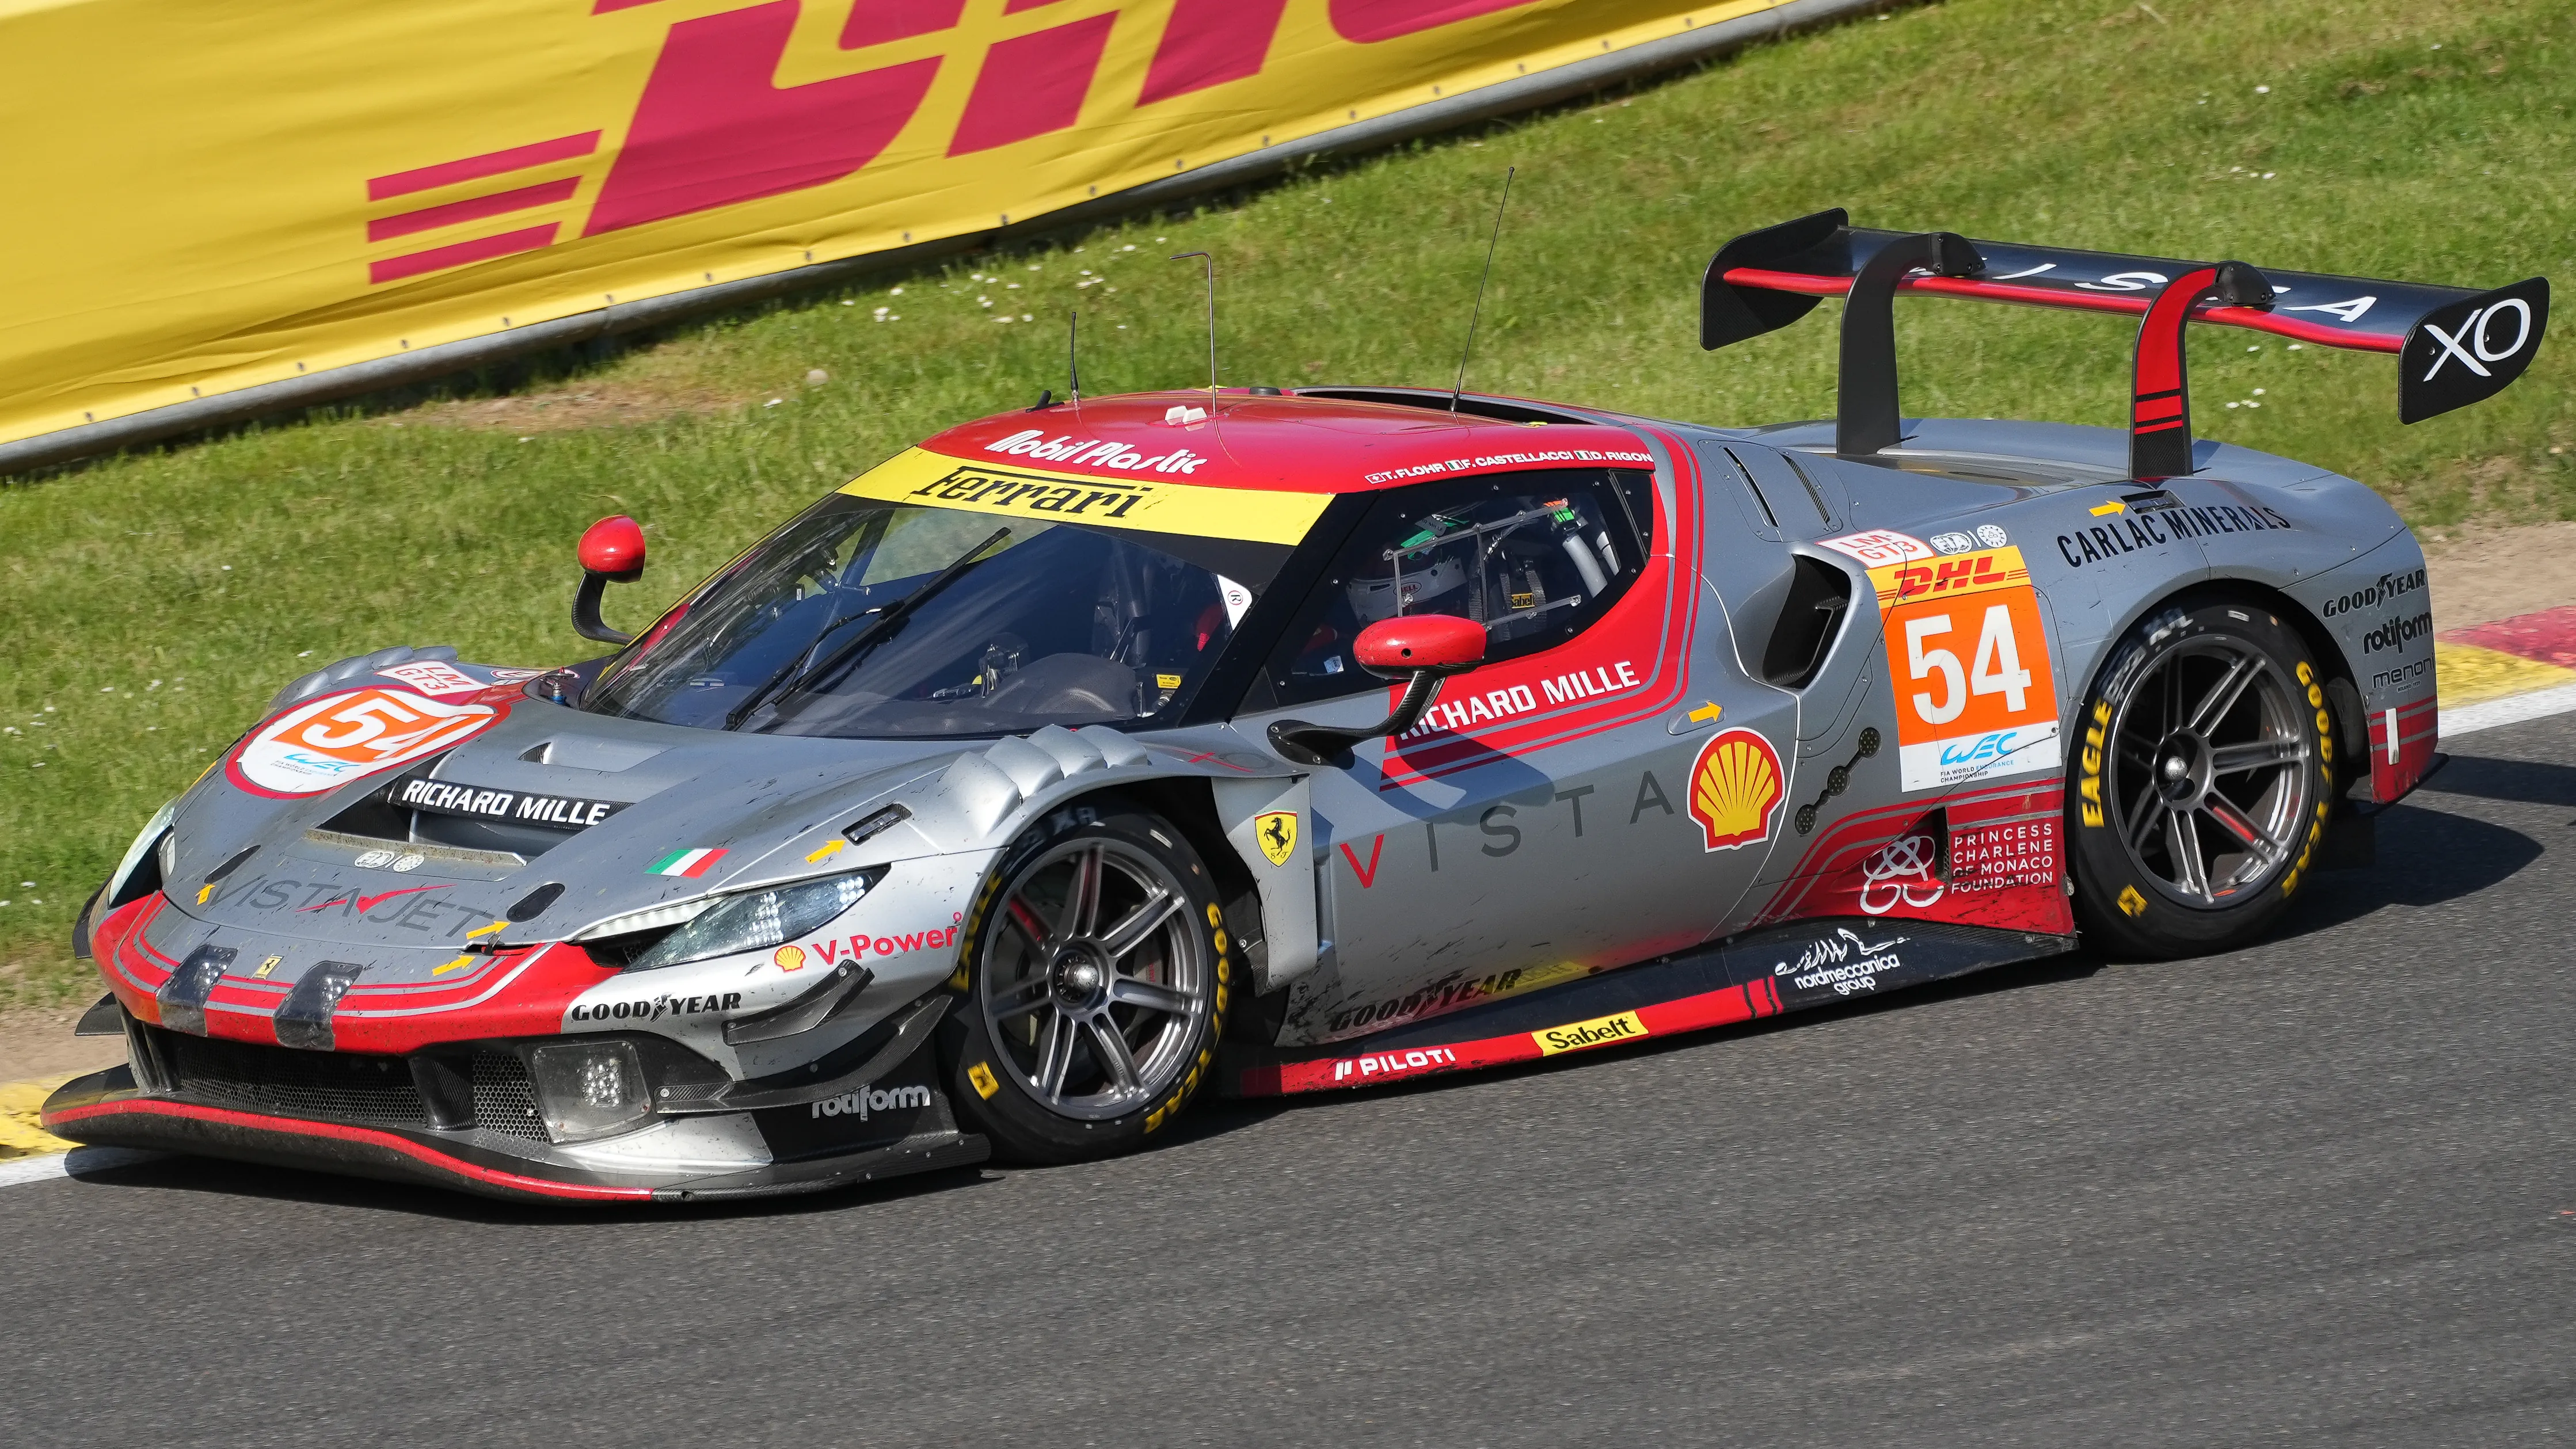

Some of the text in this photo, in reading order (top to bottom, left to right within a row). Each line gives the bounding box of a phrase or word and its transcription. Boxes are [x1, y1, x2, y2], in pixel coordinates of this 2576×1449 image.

[2423, 298, 2531, 382] XO
[984, 429, 1208, 474] Mobil Plastic
[910, 466, 1154, 518] Ferrari
[1839, 534, 1892, 548] LM
[1858, 541, 1917, 560] GT3
[2057, 506, 2292, 568] CARLAC MINERALS
[1894, 556, 2006, 598] DHL
[2363, 612, 2433, 655] rotiform
[395, 668, 450, 691] GT3
[423, 667, 474, 686] LM
[1905, 604, 2032, 725] 54
[2372, 652, 2434, 689] menoni
[1540, 661, 1641, 706] MILLE
[301, 697, 471, 760] 54
[283, 753, 362, 772] WEC
[1940, 732, 2017, 766] WEC
[2082, 695, 2113, 828] EAGLE
[1940, 771, 1988, 783] CHAMPIONSHIP
[1952, 767, 1974, 775] WORLD
[1976, 760, 2015, 771] ENDURANCE
[402, 780, 611, 826] RICHARD MILLE
[1340, 770, 1676, 889] VISTA
[1954, 823, 2053, 849] PRINCESS
[1953, 855, 2053, 877] OF MONACO
[1954, 839, 2053, 864] CHARLENE
[1951, 871, 2053, 894] FOUNDATION
[811, 926, 958, 966] V-Power
[1794, 954, 1900, 990] nordmeccanica
[1833, 975, 1876, 996] group
[1546, 1017, 1637, 1050] Sabelt
[1360, 1048, 1456, 1077] PILOTI
[812, 1085, 931, 1122] rotiform
